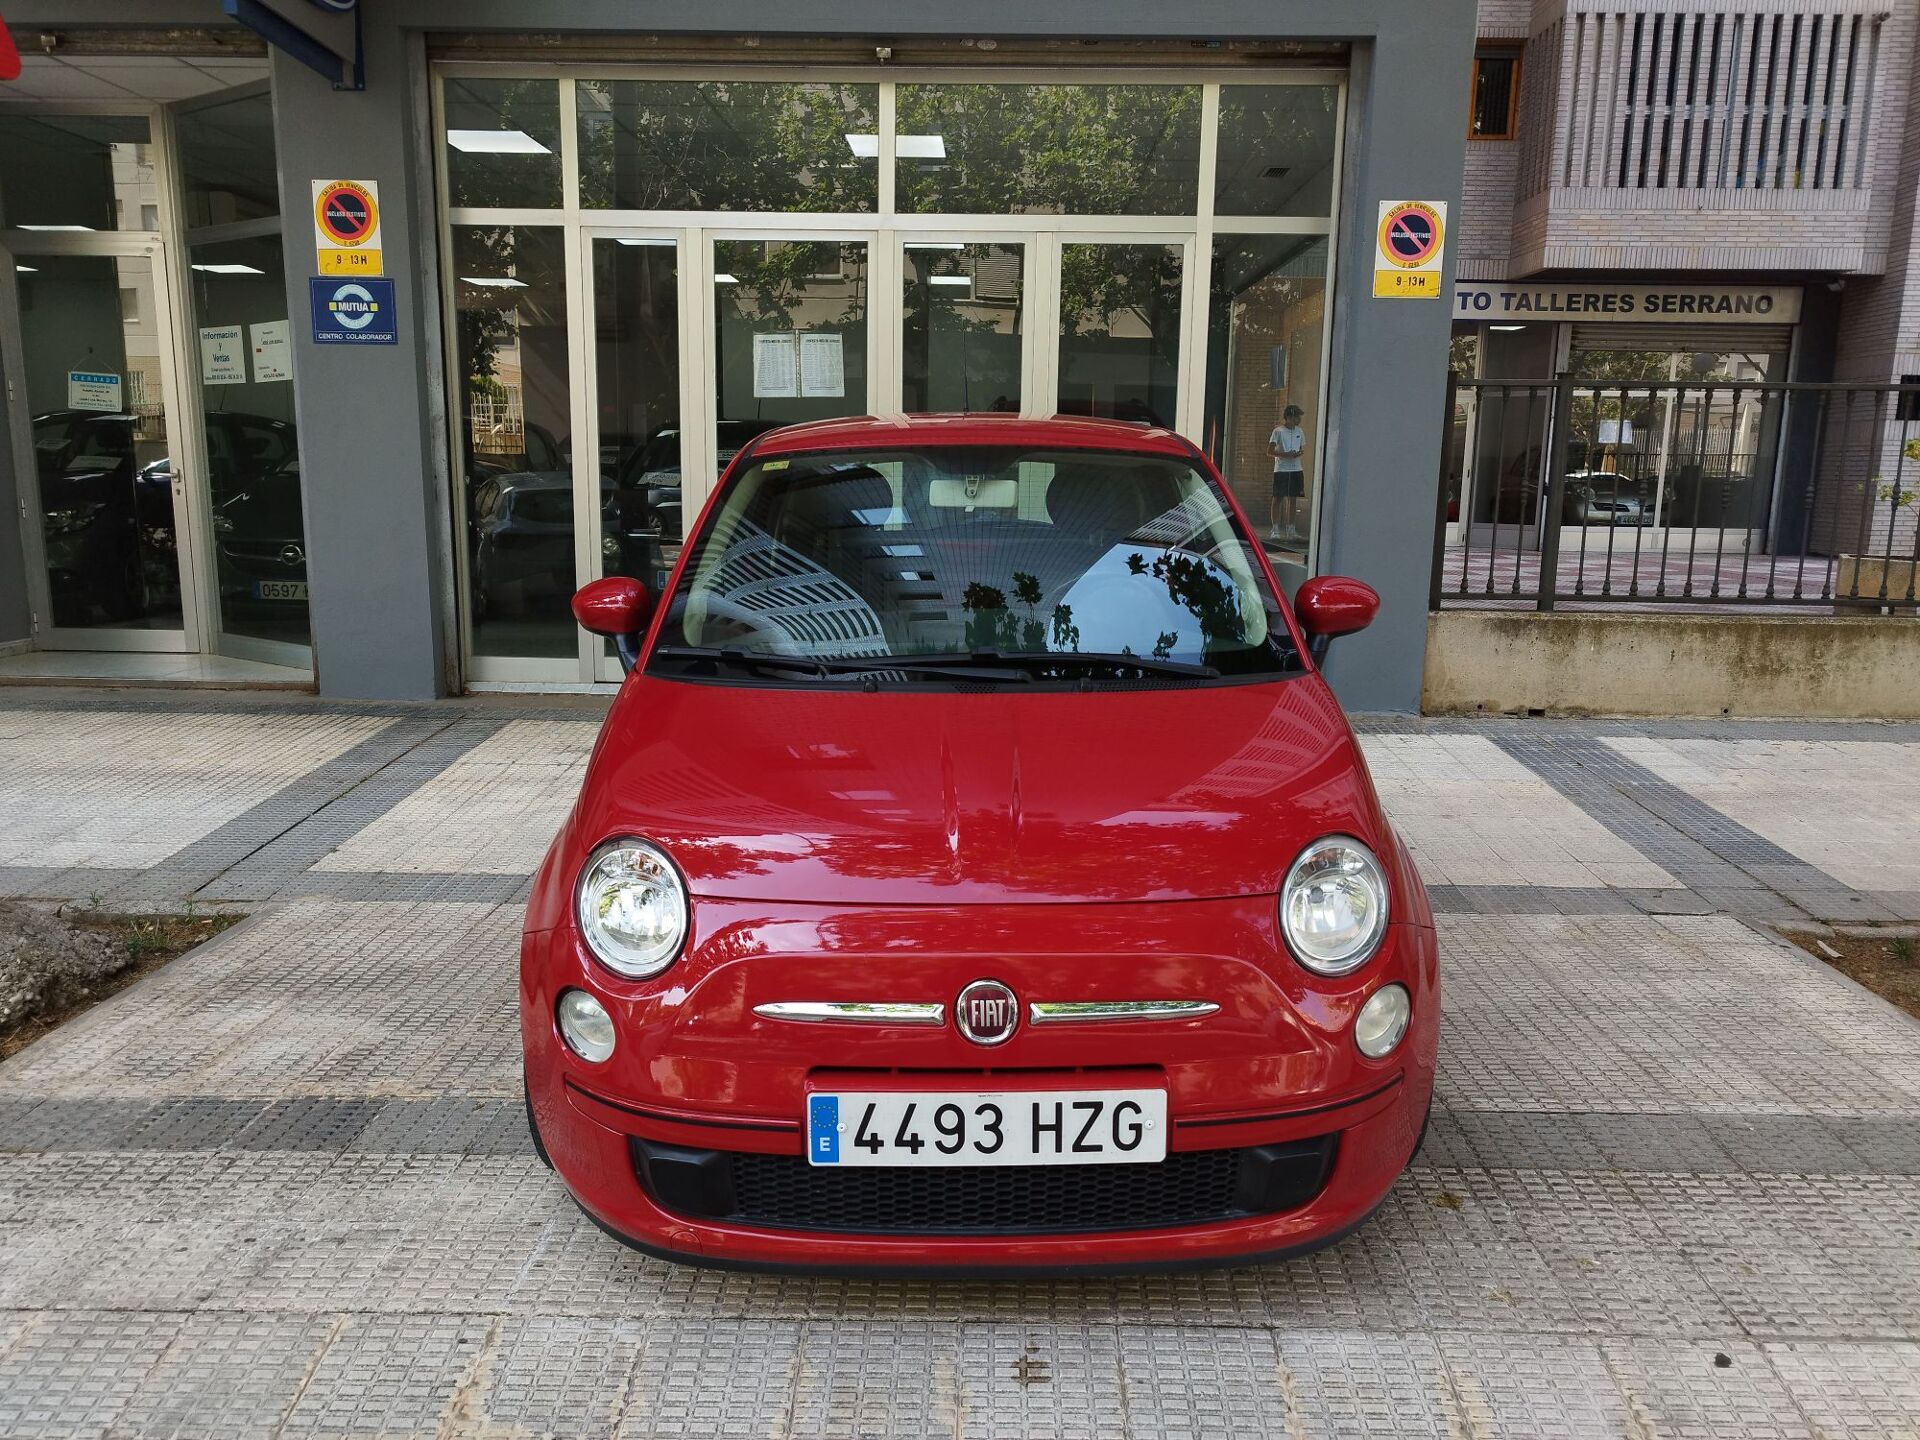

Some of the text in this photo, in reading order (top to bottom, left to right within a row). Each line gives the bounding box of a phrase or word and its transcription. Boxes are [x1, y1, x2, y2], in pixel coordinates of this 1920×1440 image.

[338, 301, 369, 312] MUTUA
[1500, 292, 1635, 314] TALLERES
[1644, 294, 1774, 315] SERRANO
[318, 332, 393, 341] CENTRO COLABORADOR
[262, 584, 298, 598] 0597
[971, 999, 1006, 1027] FIAT
[853, 1100, 1144, 1155] 4493 HZG
[819, 1137, 831, 1152] E
